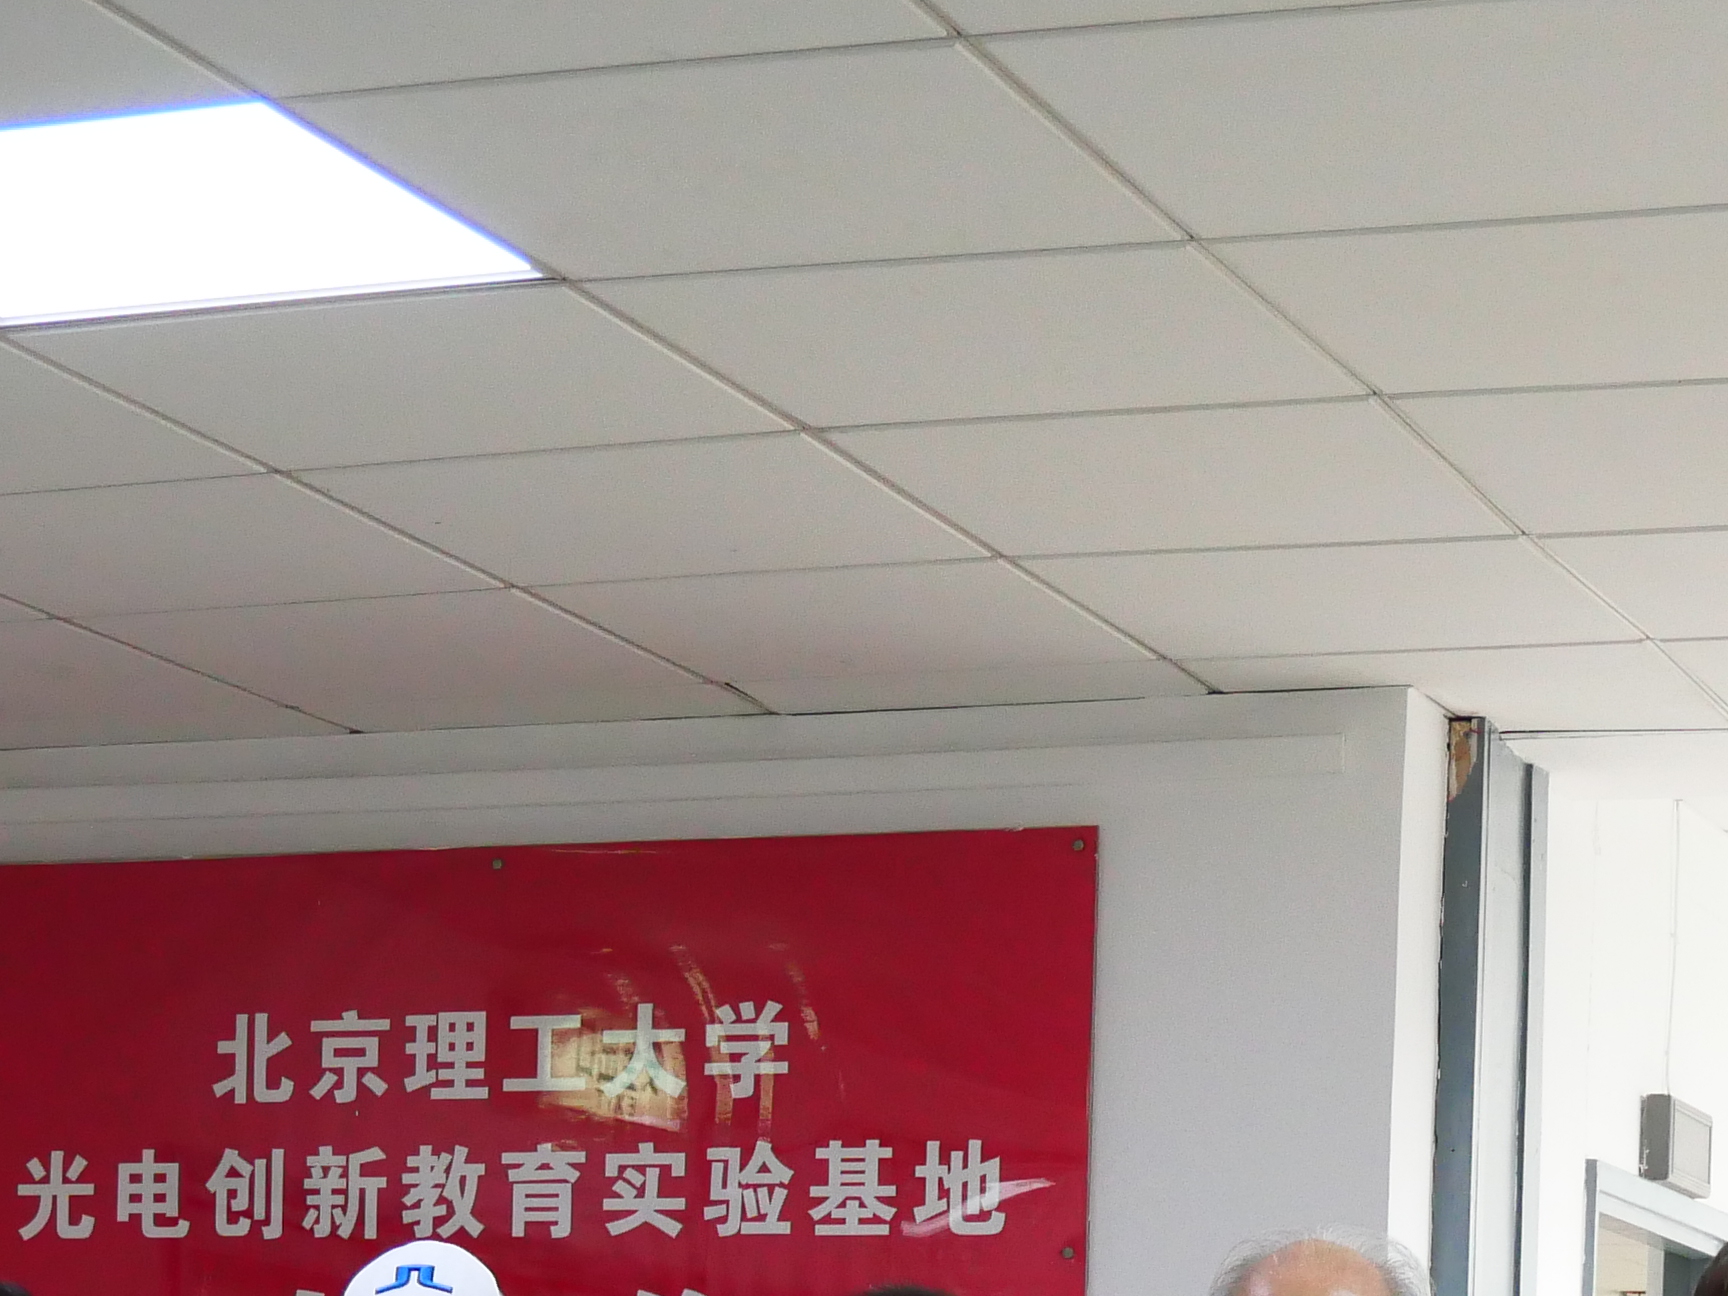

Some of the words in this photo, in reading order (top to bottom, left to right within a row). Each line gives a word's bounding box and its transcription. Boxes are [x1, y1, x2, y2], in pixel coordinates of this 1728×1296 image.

[212, 1000, 789, 1104] 北京理工大学
[17, 1138, 1007, 1240] 光电创新教育实验基地
